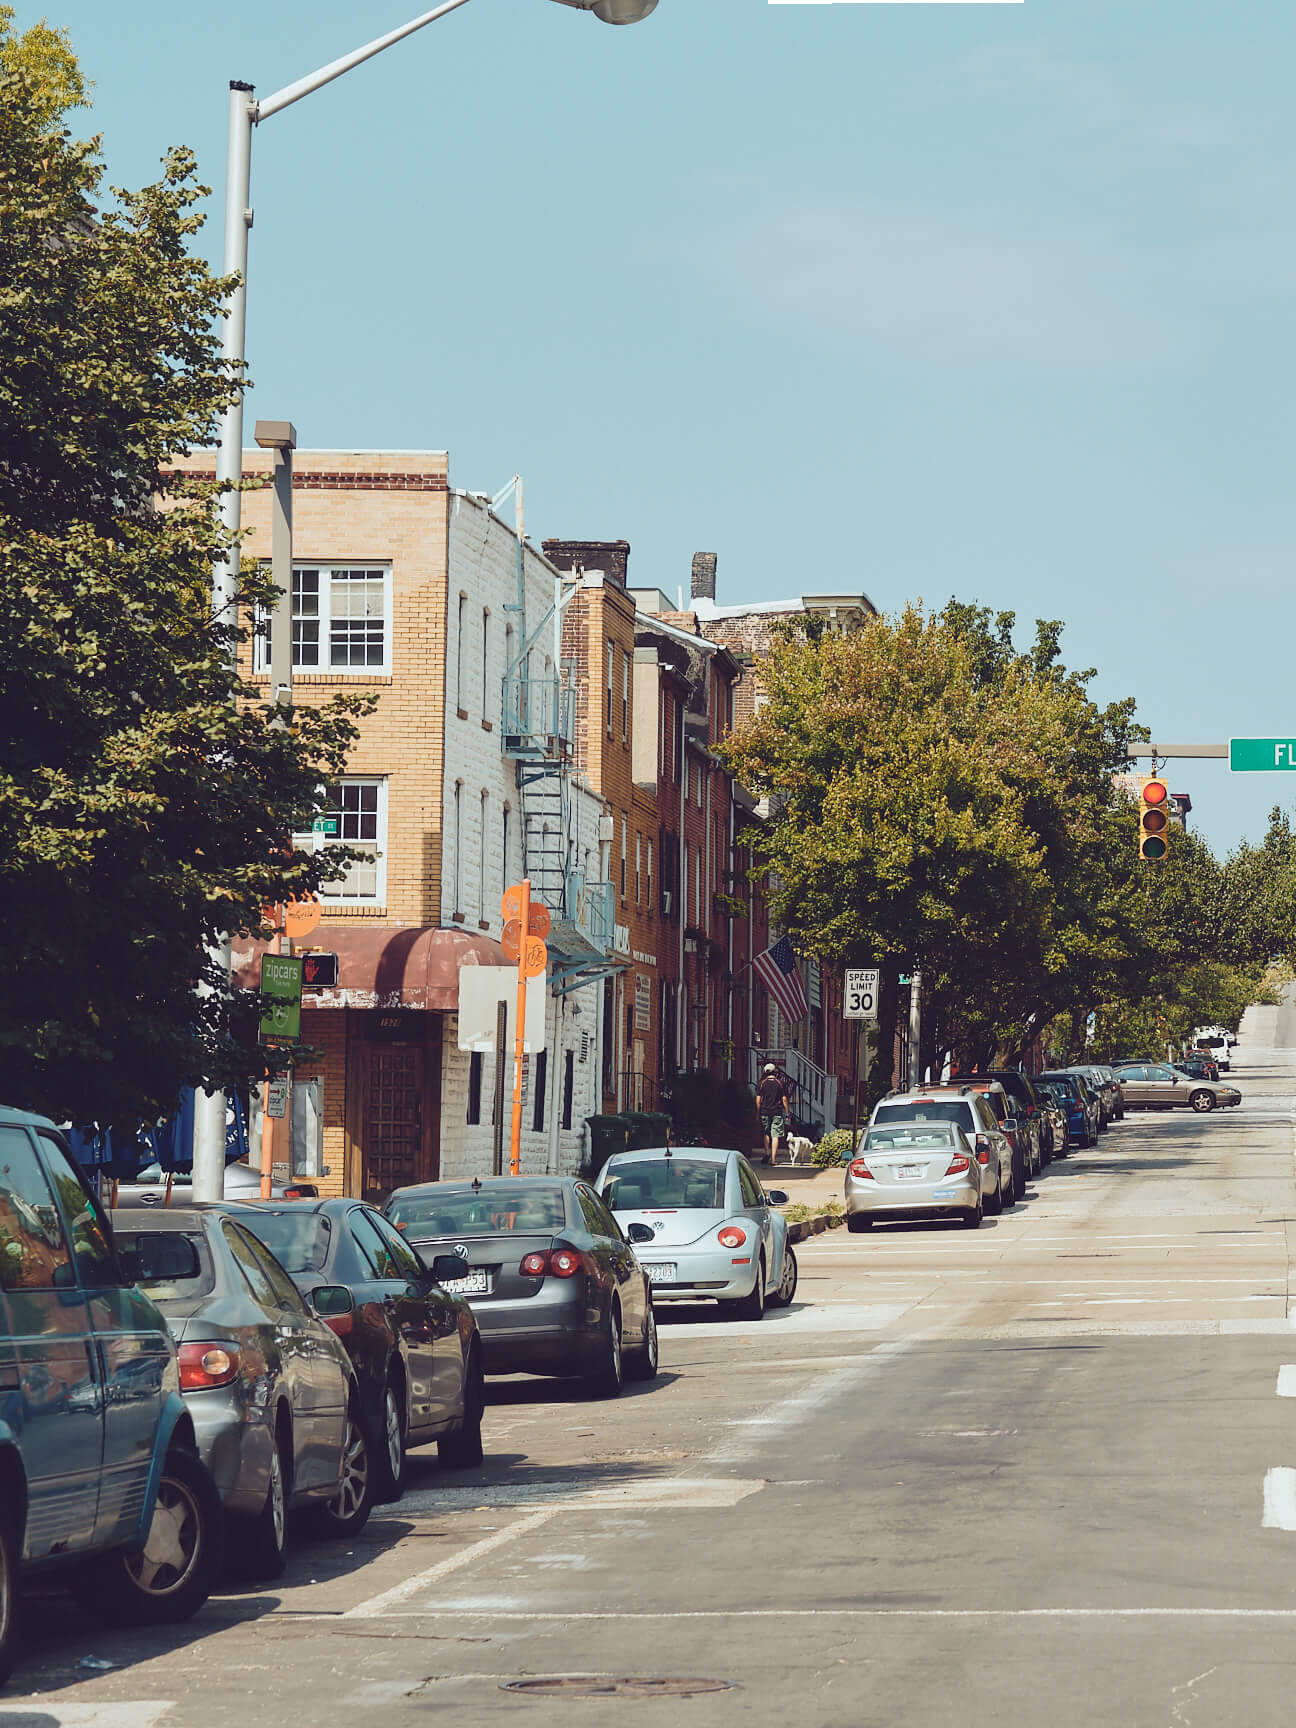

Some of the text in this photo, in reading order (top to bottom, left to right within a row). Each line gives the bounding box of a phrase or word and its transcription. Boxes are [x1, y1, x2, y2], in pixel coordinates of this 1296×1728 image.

[265, 960, 298, 982] zipcars
[848, 973, 876, 982] SPEED
[850, 982, 873, 991] LIMIT
[849, 993, 873, 1011] 30
